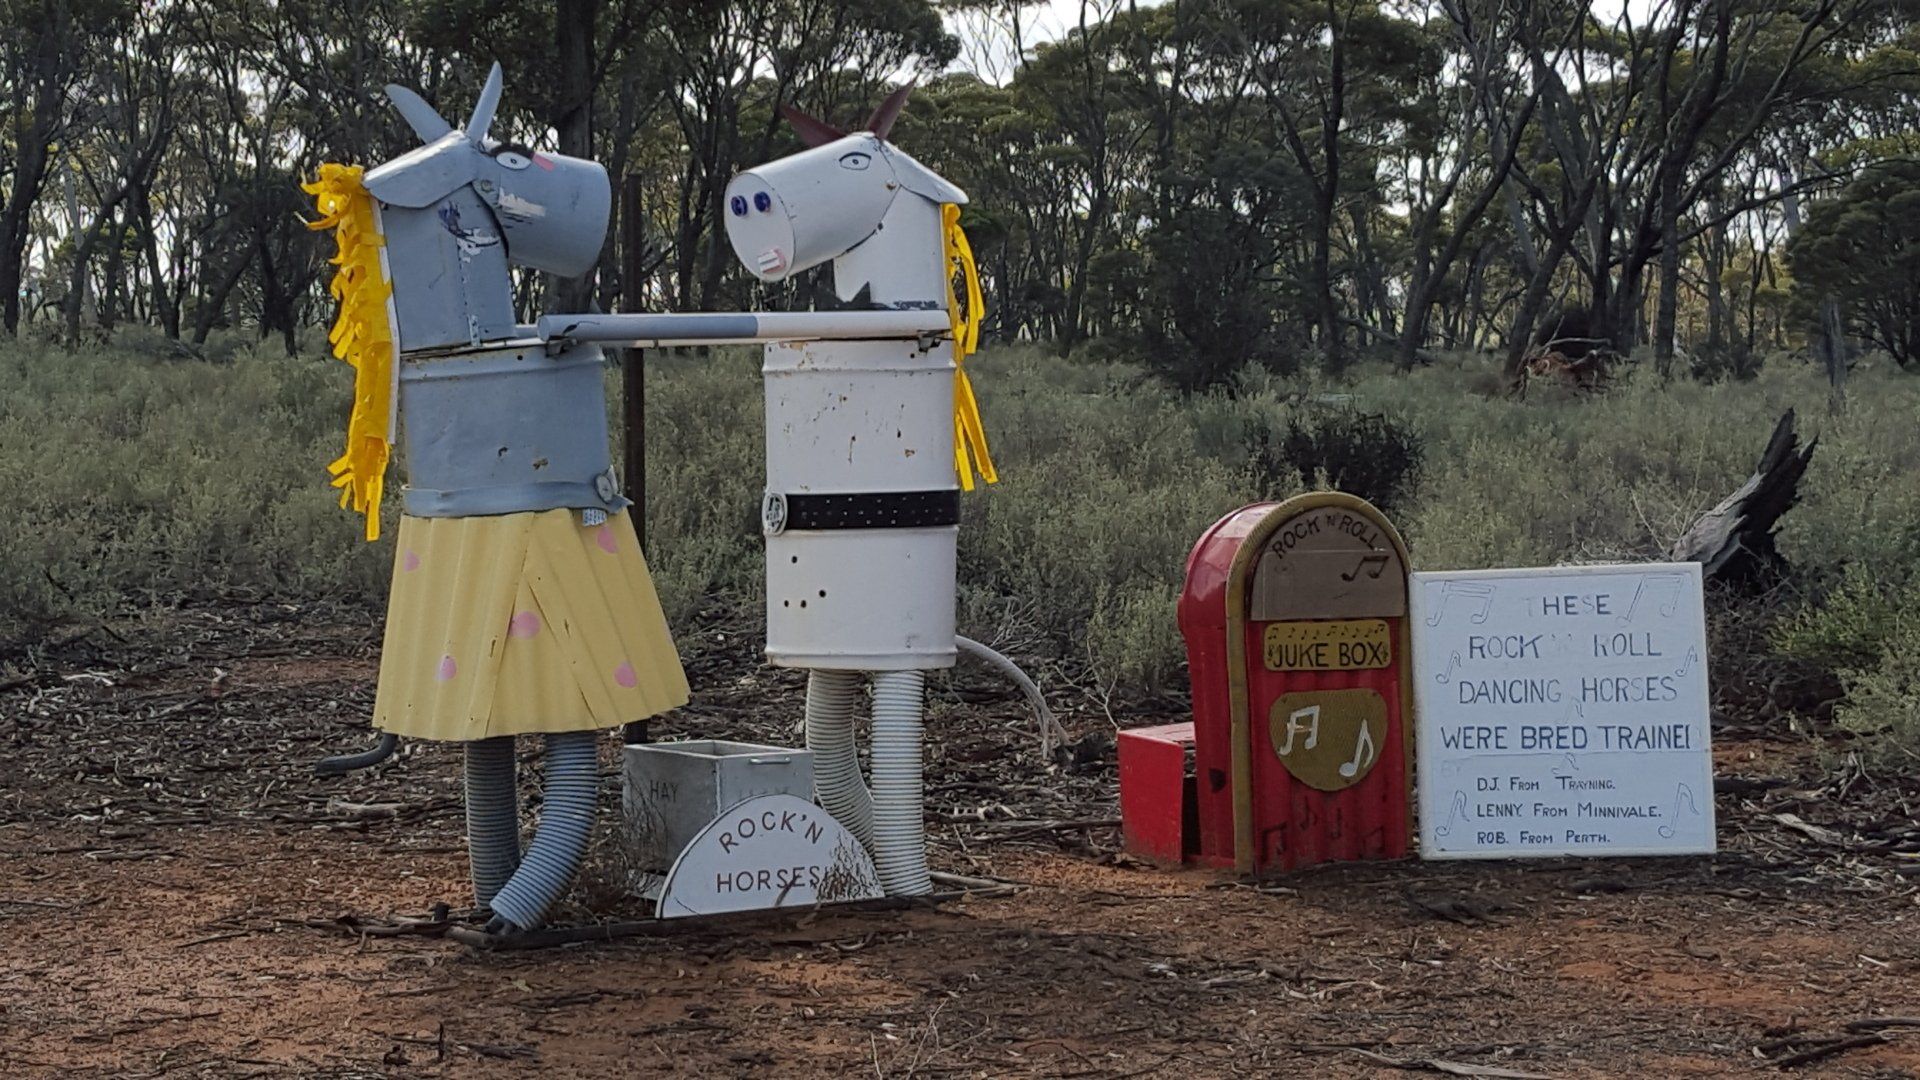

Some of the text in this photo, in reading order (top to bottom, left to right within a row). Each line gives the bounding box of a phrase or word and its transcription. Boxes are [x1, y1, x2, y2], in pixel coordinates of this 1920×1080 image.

[1272, 516, 1321, 559] ROCK
[1338, 514, 1379, 550] ROLL
[1273, 641, 1383, 668] JUKE BOX
[1469, 635, 1543, 659] ROCK
[1594, 632, 1663, 657] ROLL
[1459, 676, 1678, 704] DANCING HORSES
[1440, 725, 1508, 750] WERE
[1521, 725, 1588, 750] BRED
[650, 780, 679, 804] HAY
[717, 866, 820, 893] HORSES
